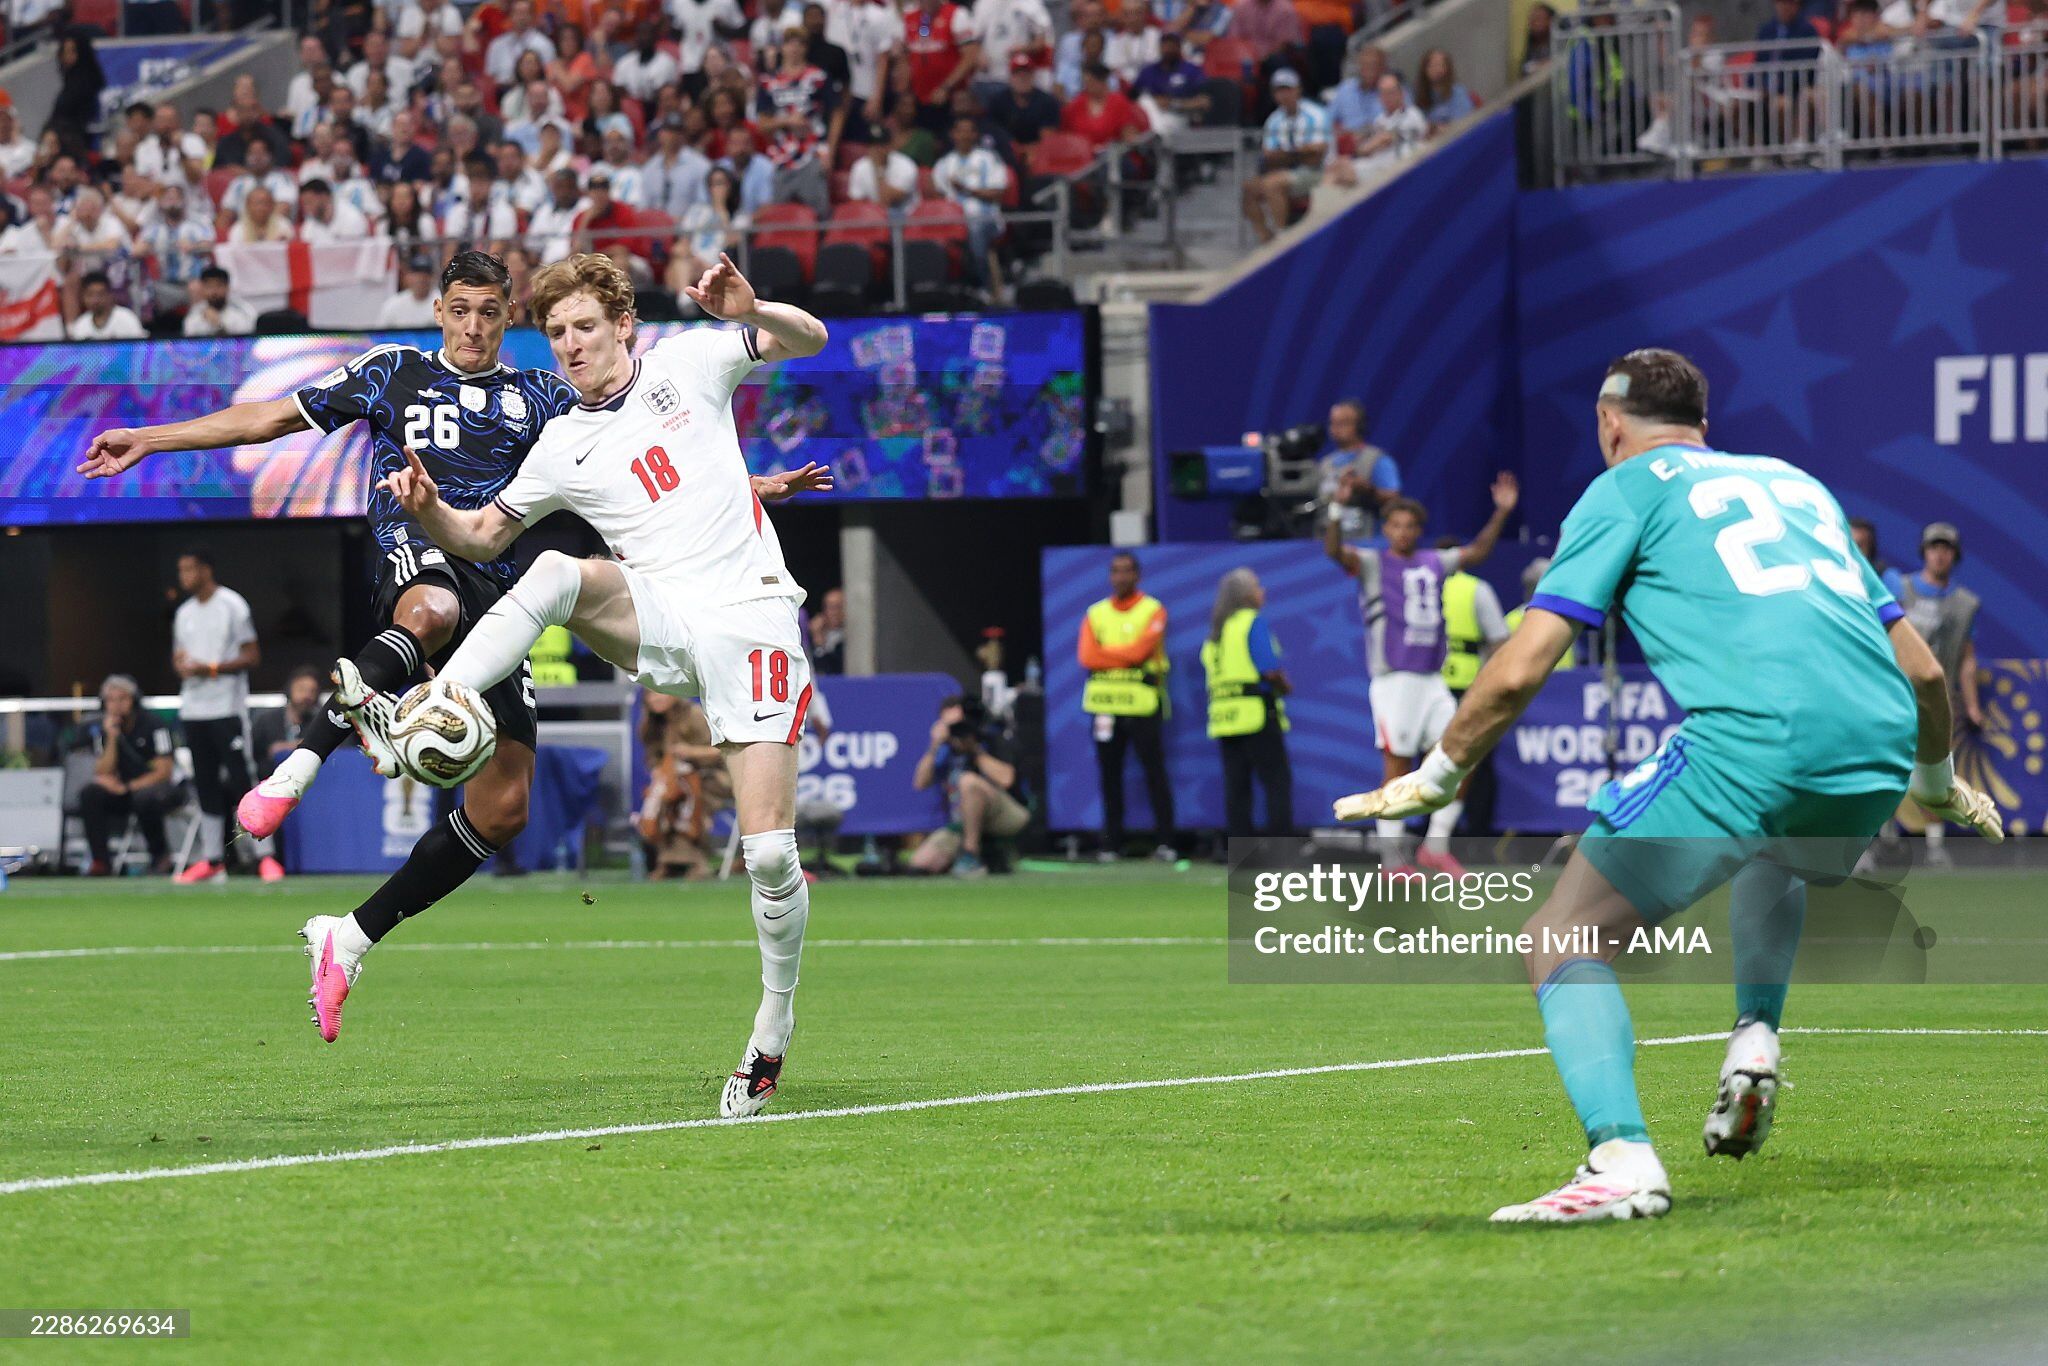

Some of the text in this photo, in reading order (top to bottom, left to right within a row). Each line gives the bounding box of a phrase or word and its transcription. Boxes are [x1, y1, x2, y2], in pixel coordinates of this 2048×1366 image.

[404, 404, 460, 450] 26
[630, 445, 681, 503] 18
[1688, 475, 1871, 602] 23
[748, 649, 789, 703] 18
[825, 731, 898, 769] CUP
